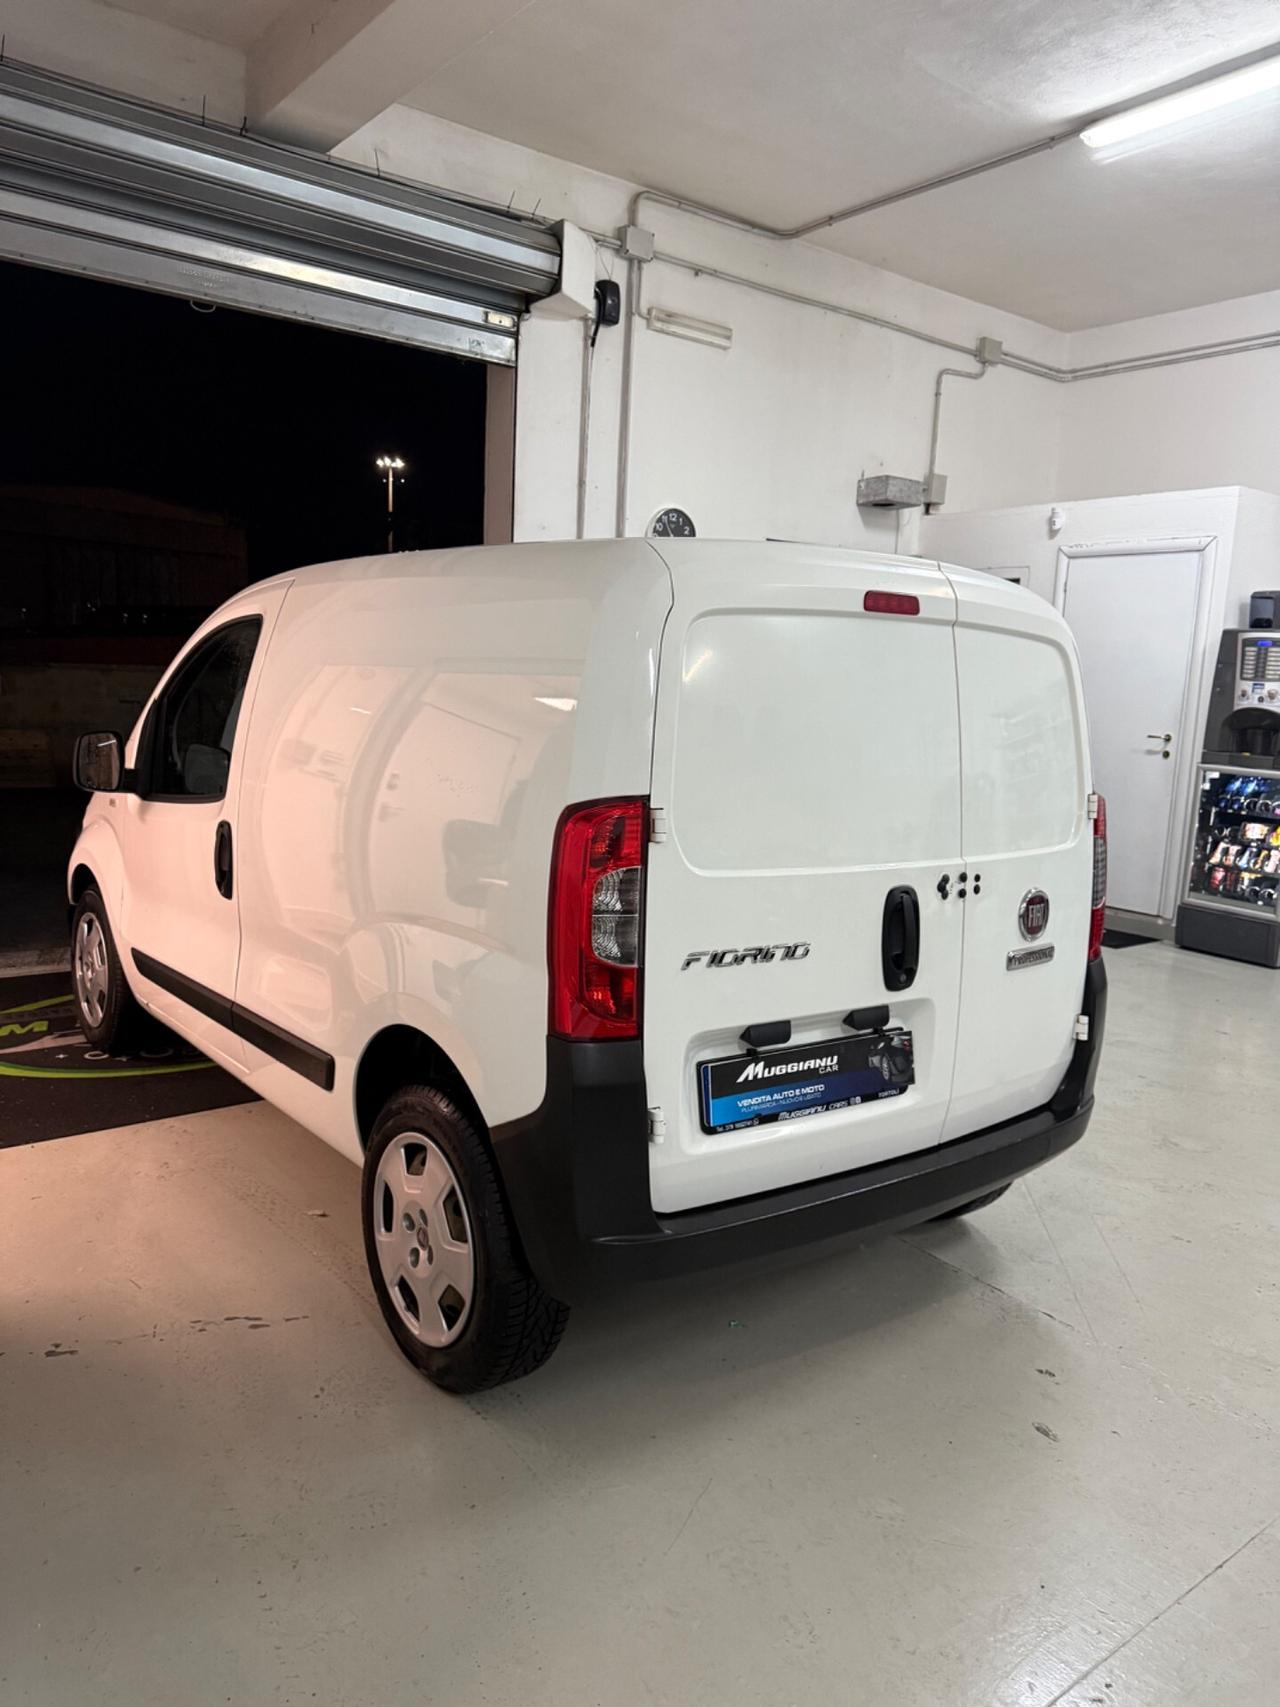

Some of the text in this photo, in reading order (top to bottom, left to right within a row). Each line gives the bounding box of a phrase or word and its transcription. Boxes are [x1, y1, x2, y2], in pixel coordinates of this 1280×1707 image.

[669, 513, 677, 521] 12
[684, 526, 690, 535] 2
[819, 1064, 839, 1075] CAR
[737, 1084, 825, 1107] VENDITA AUTO E MOTO
[829, 1100, 848, 1110] CARS
